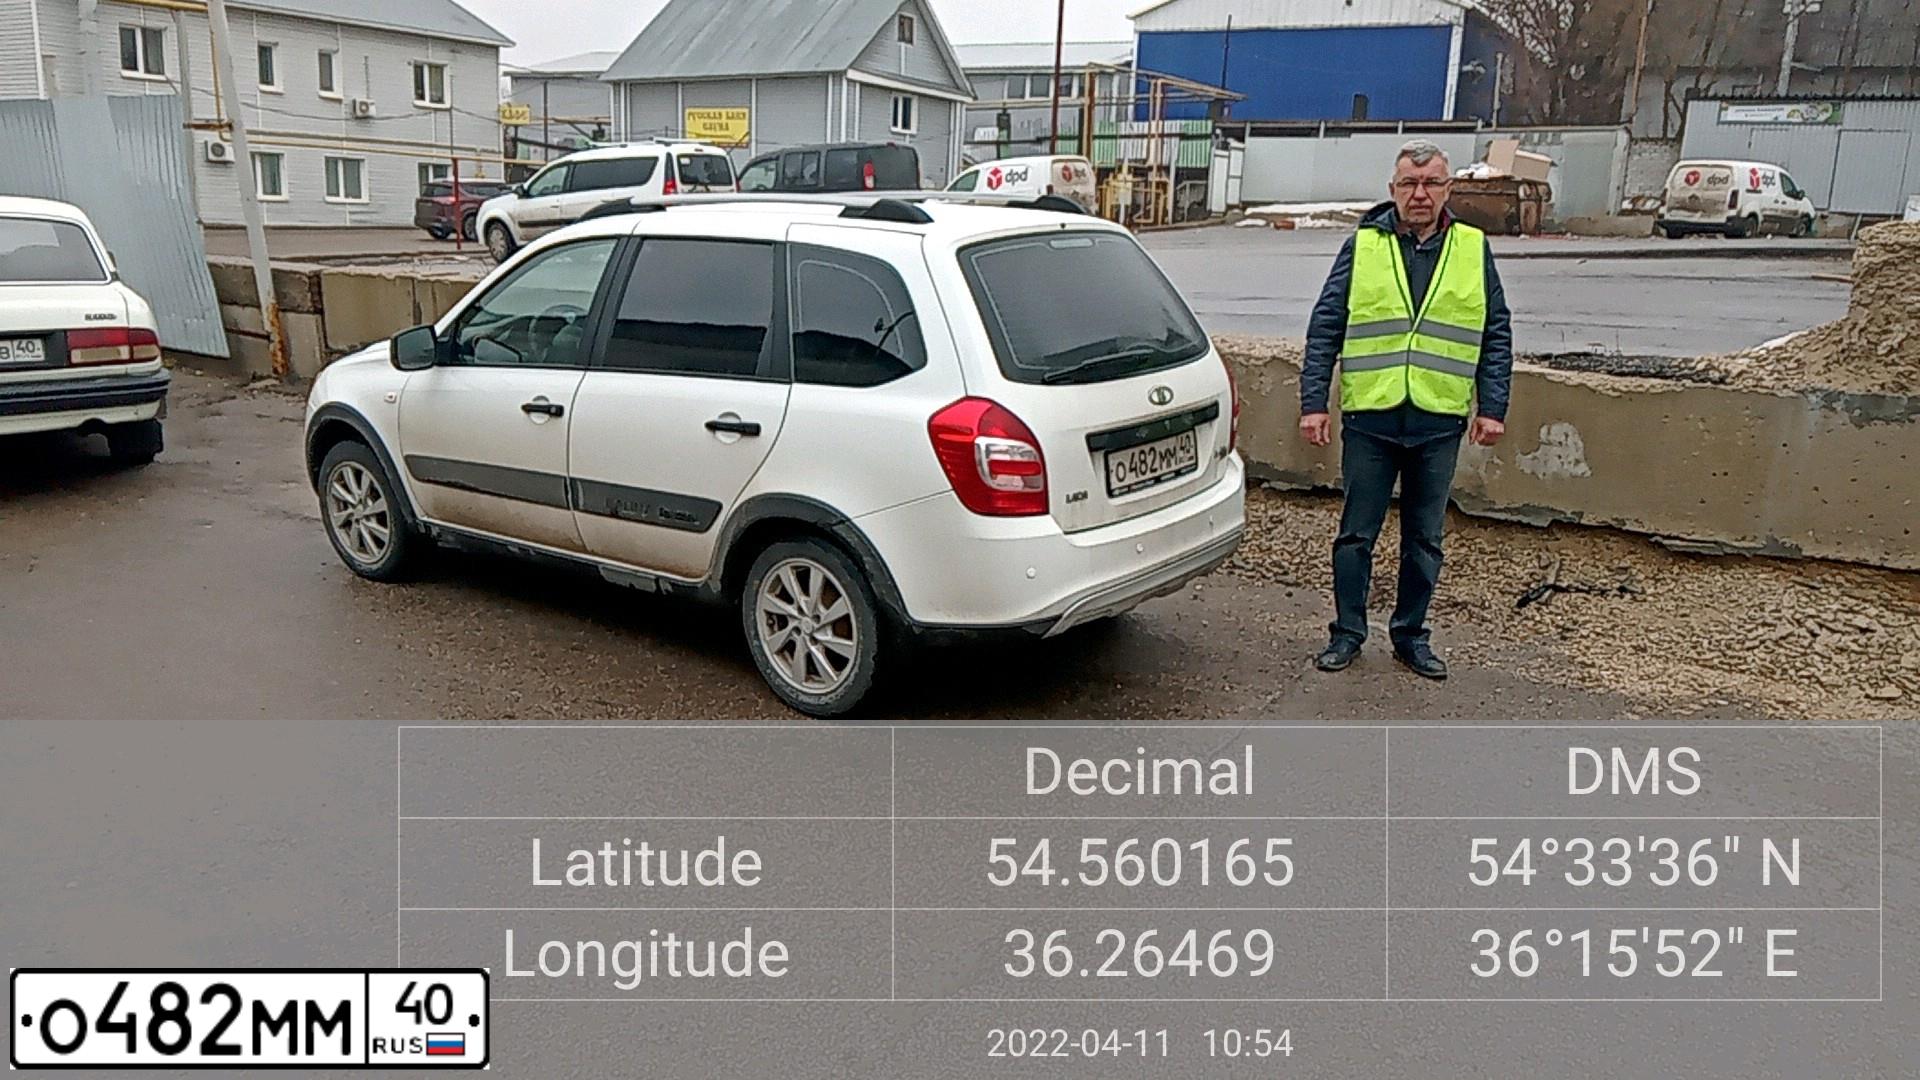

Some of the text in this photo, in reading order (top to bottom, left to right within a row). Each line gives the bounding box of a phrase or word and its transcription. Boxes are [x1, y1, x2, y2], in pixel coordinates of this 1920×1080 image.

[1005, 167, 1028, 186] dpd
[1707, 173, 1729, 186] dpd
[16, 340, 36, 354] 40
[1179, 434, 1192, 454] 40
